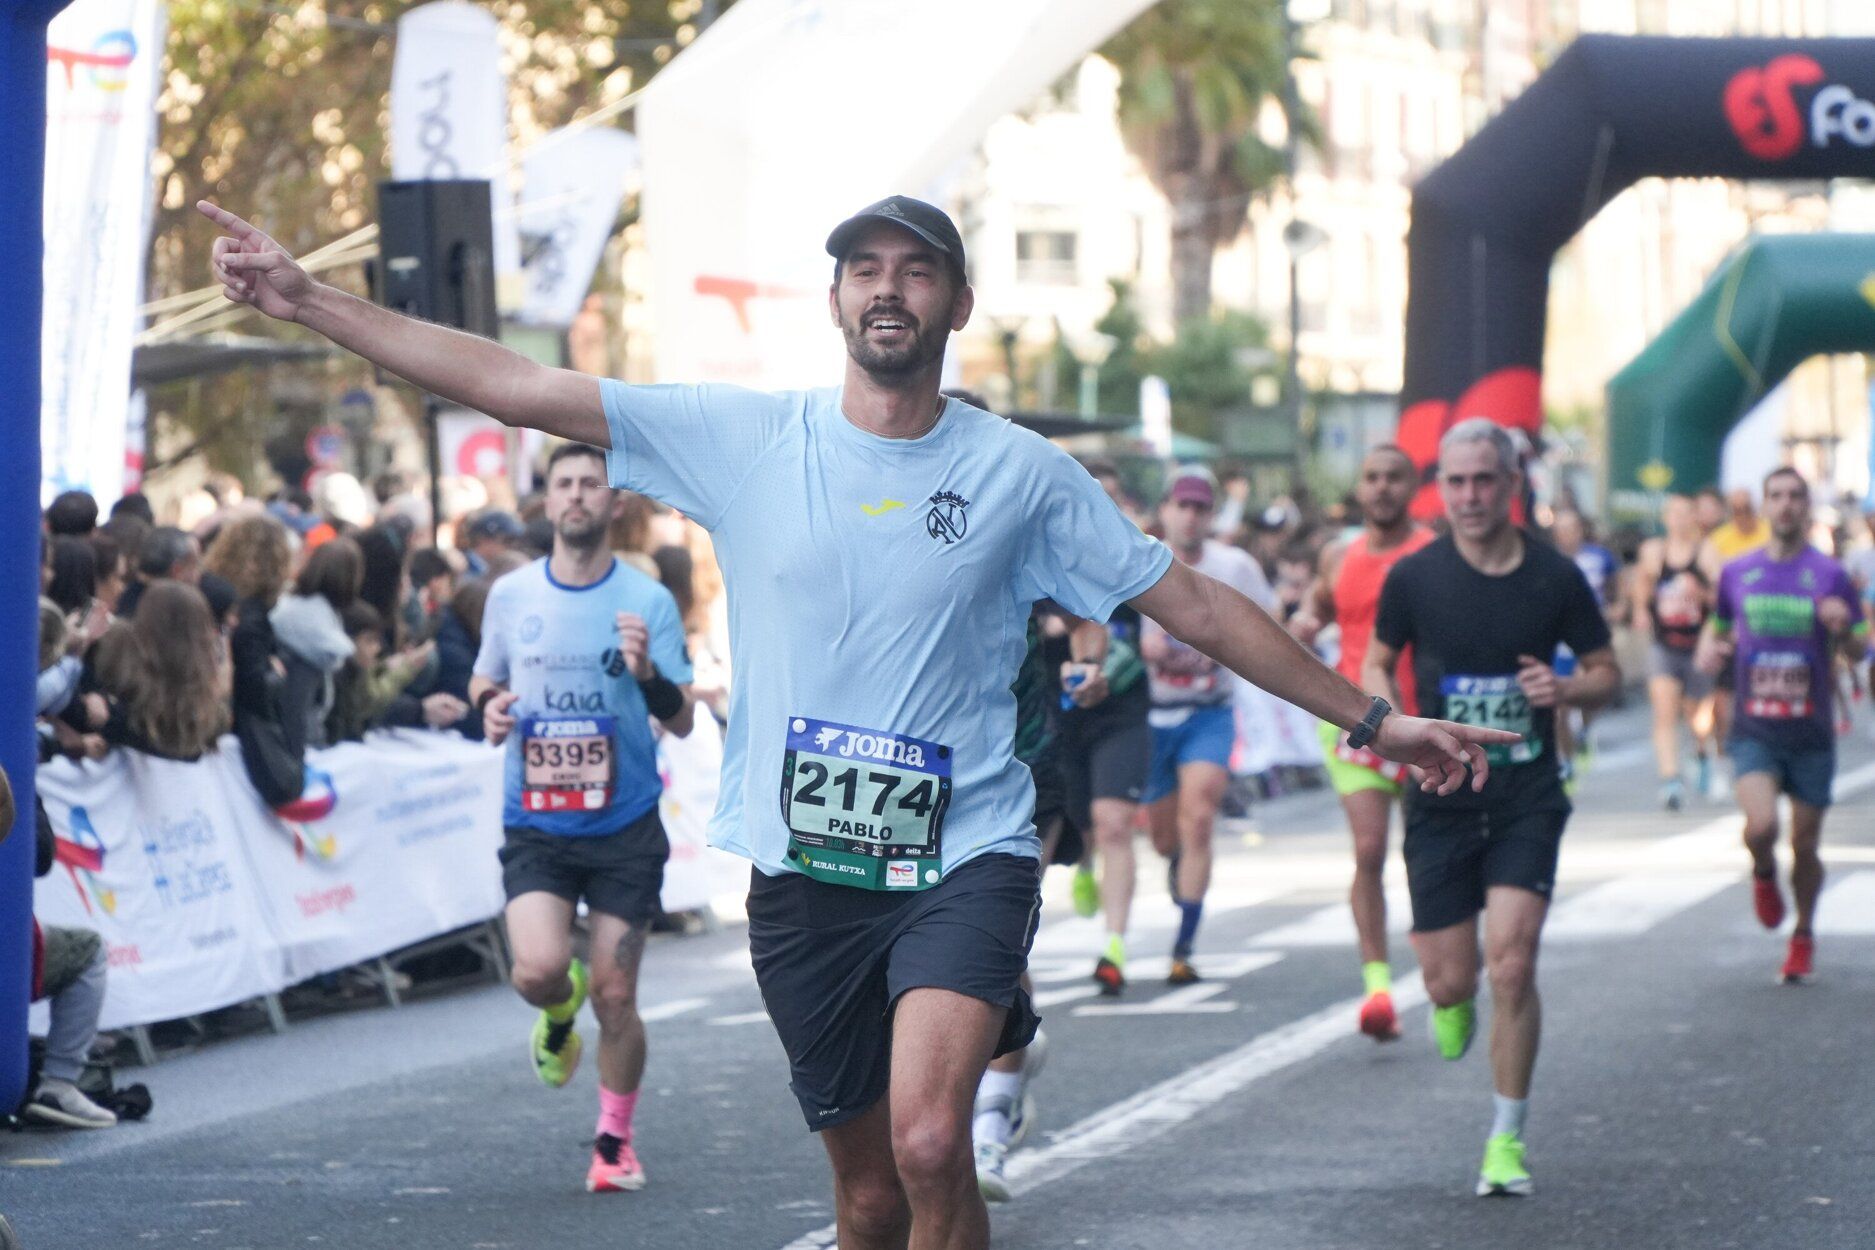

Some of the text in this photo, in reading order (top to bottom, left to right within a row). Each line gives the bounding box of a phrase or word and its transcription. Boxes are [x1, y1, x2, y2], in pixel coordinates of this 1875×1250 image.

[529, 742, 604, 768] 3395
[793, 760, 934, 818] 2174
[828, 818, 893, 841] PABLO
[905, 847, 921, 855] delta
[812, 860, 866, 876] RURAL KUTXA
